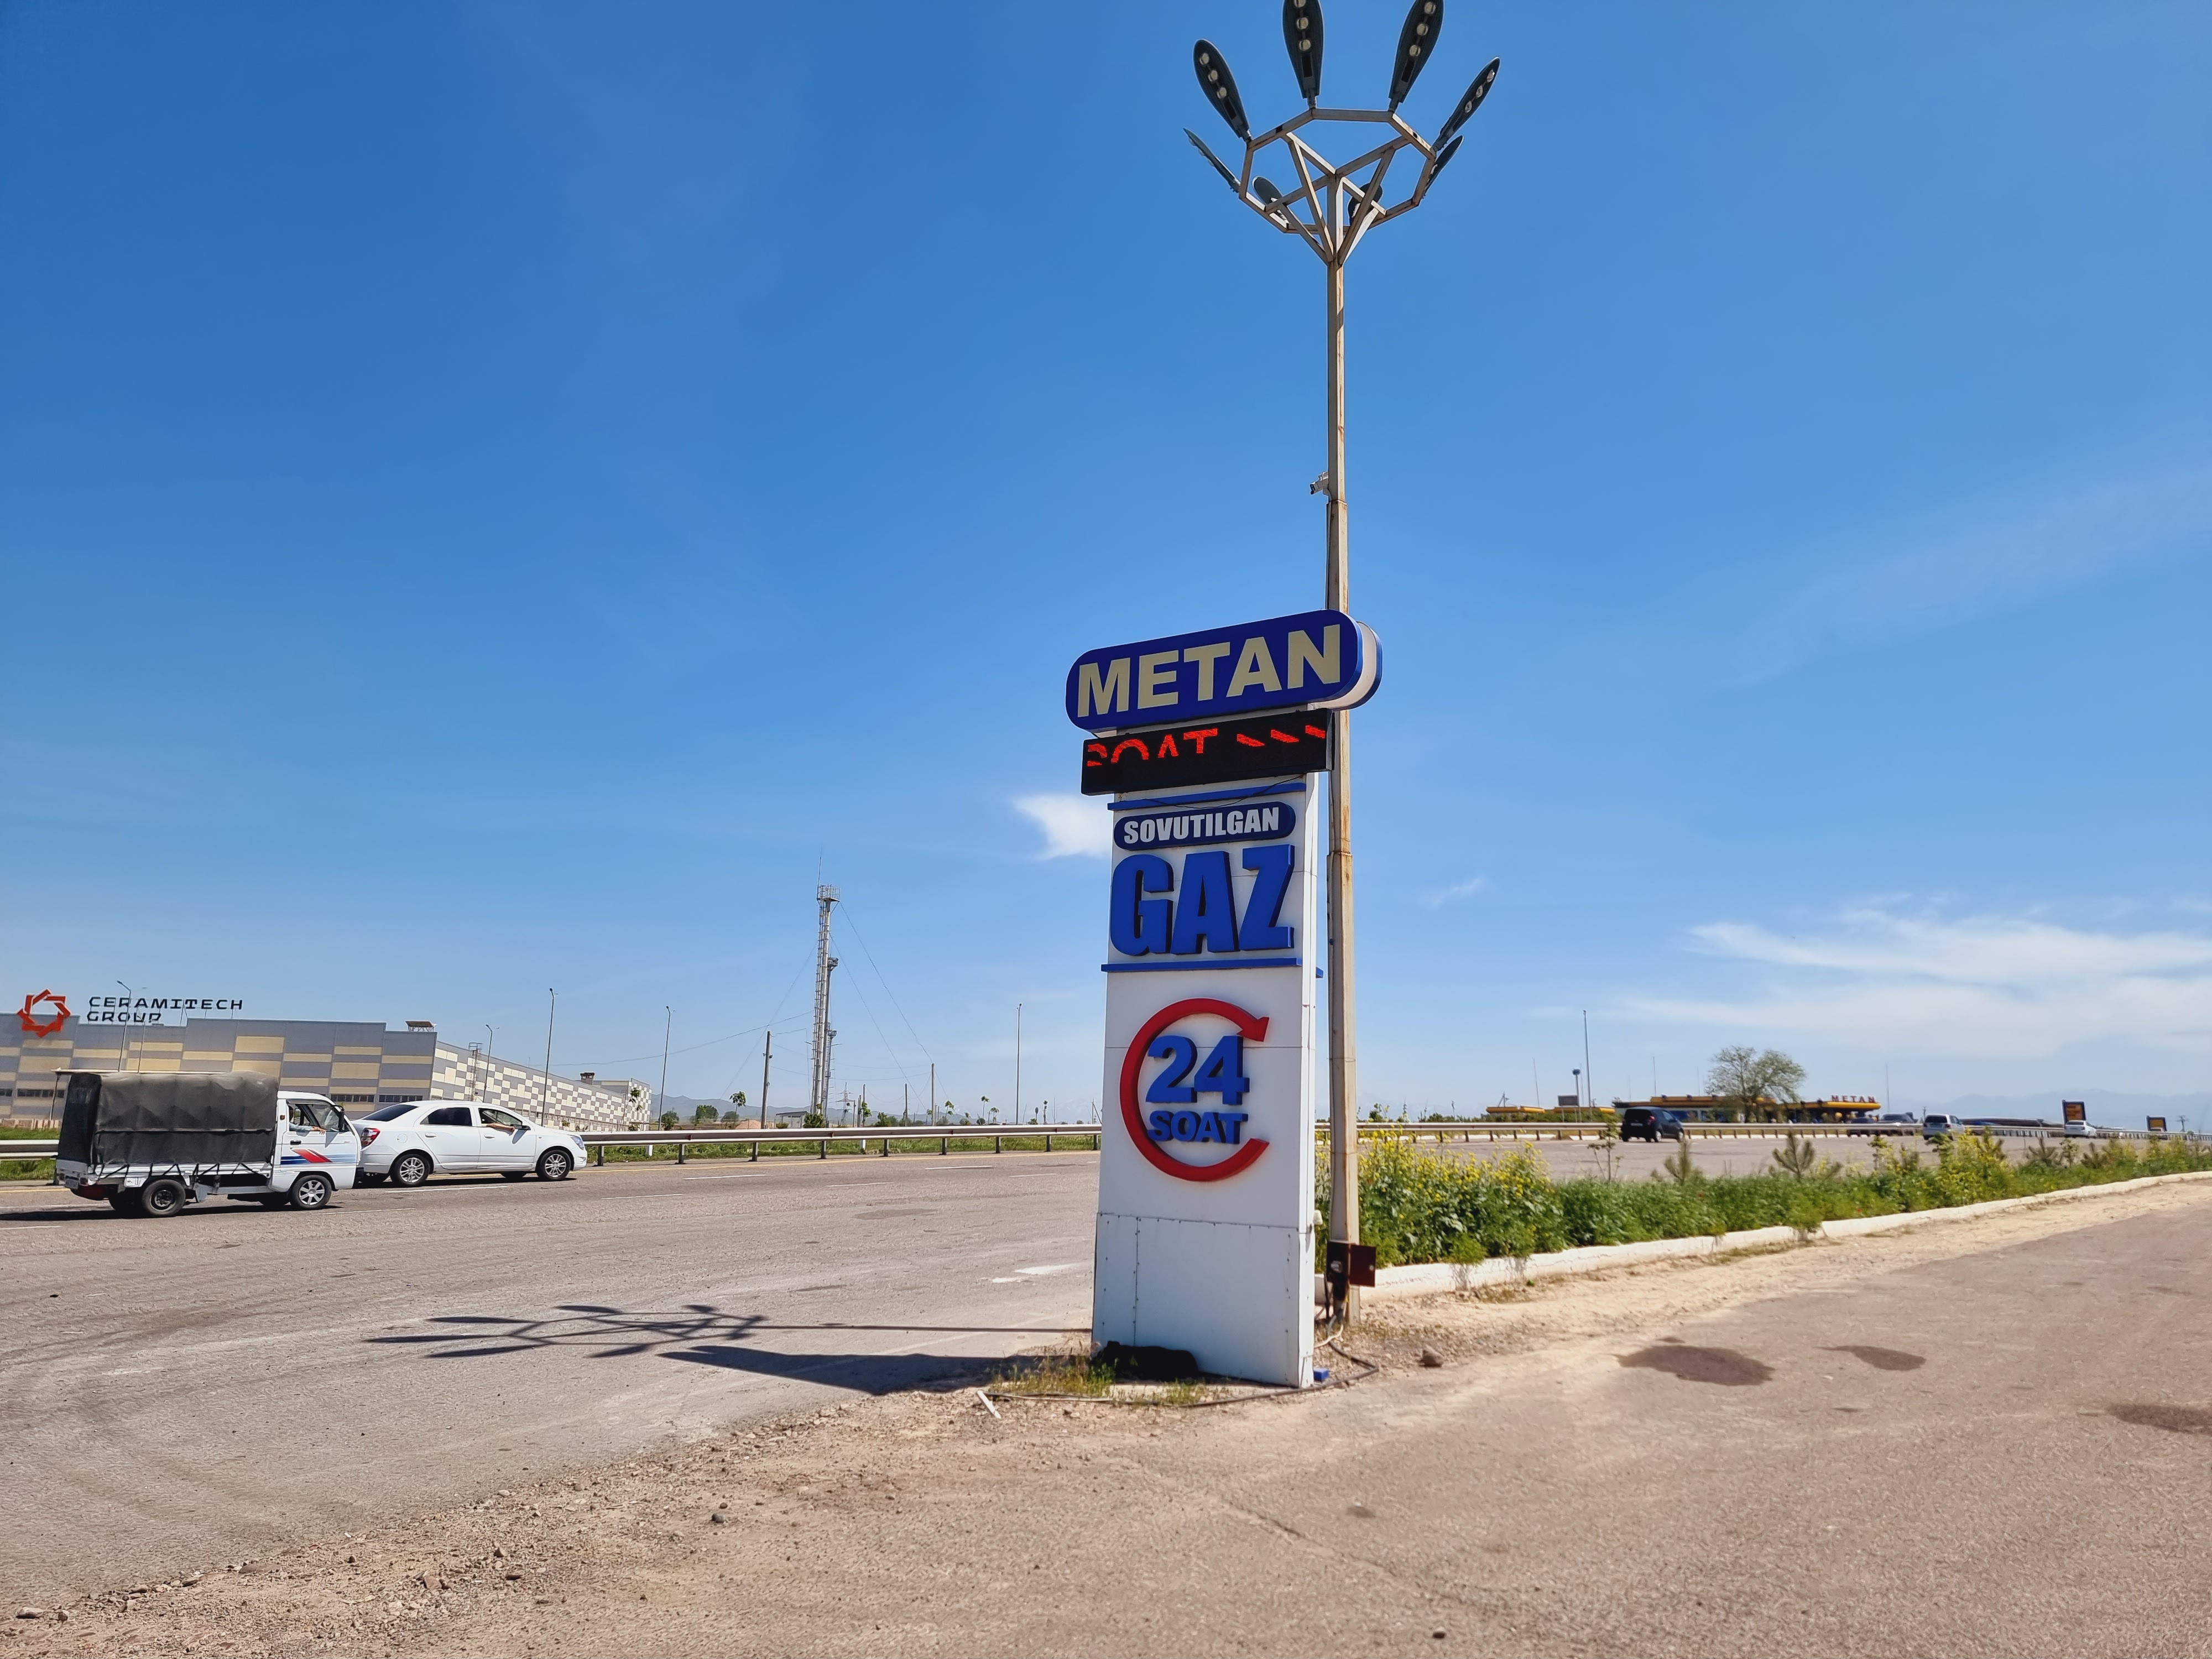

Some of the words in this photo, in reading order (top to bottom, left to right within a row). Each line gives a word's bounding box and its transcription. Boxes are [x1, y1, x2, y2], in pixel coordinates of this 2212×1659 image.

[1077, 624, 1340, 718] METAN
[1124, 807, 1279, 844] SOVUTILGAN
[1110, 844, 1295, 956] GAZ
[86, 1011, 162, 1023] GROUP
[88, 996, 243, 1010] CERAMITECH
[1146, 1035, 1250, 1105] 24
[1831, 1094, 1876, 1103] METAN
[1147, 1110, 1249, 1145] SOAT
